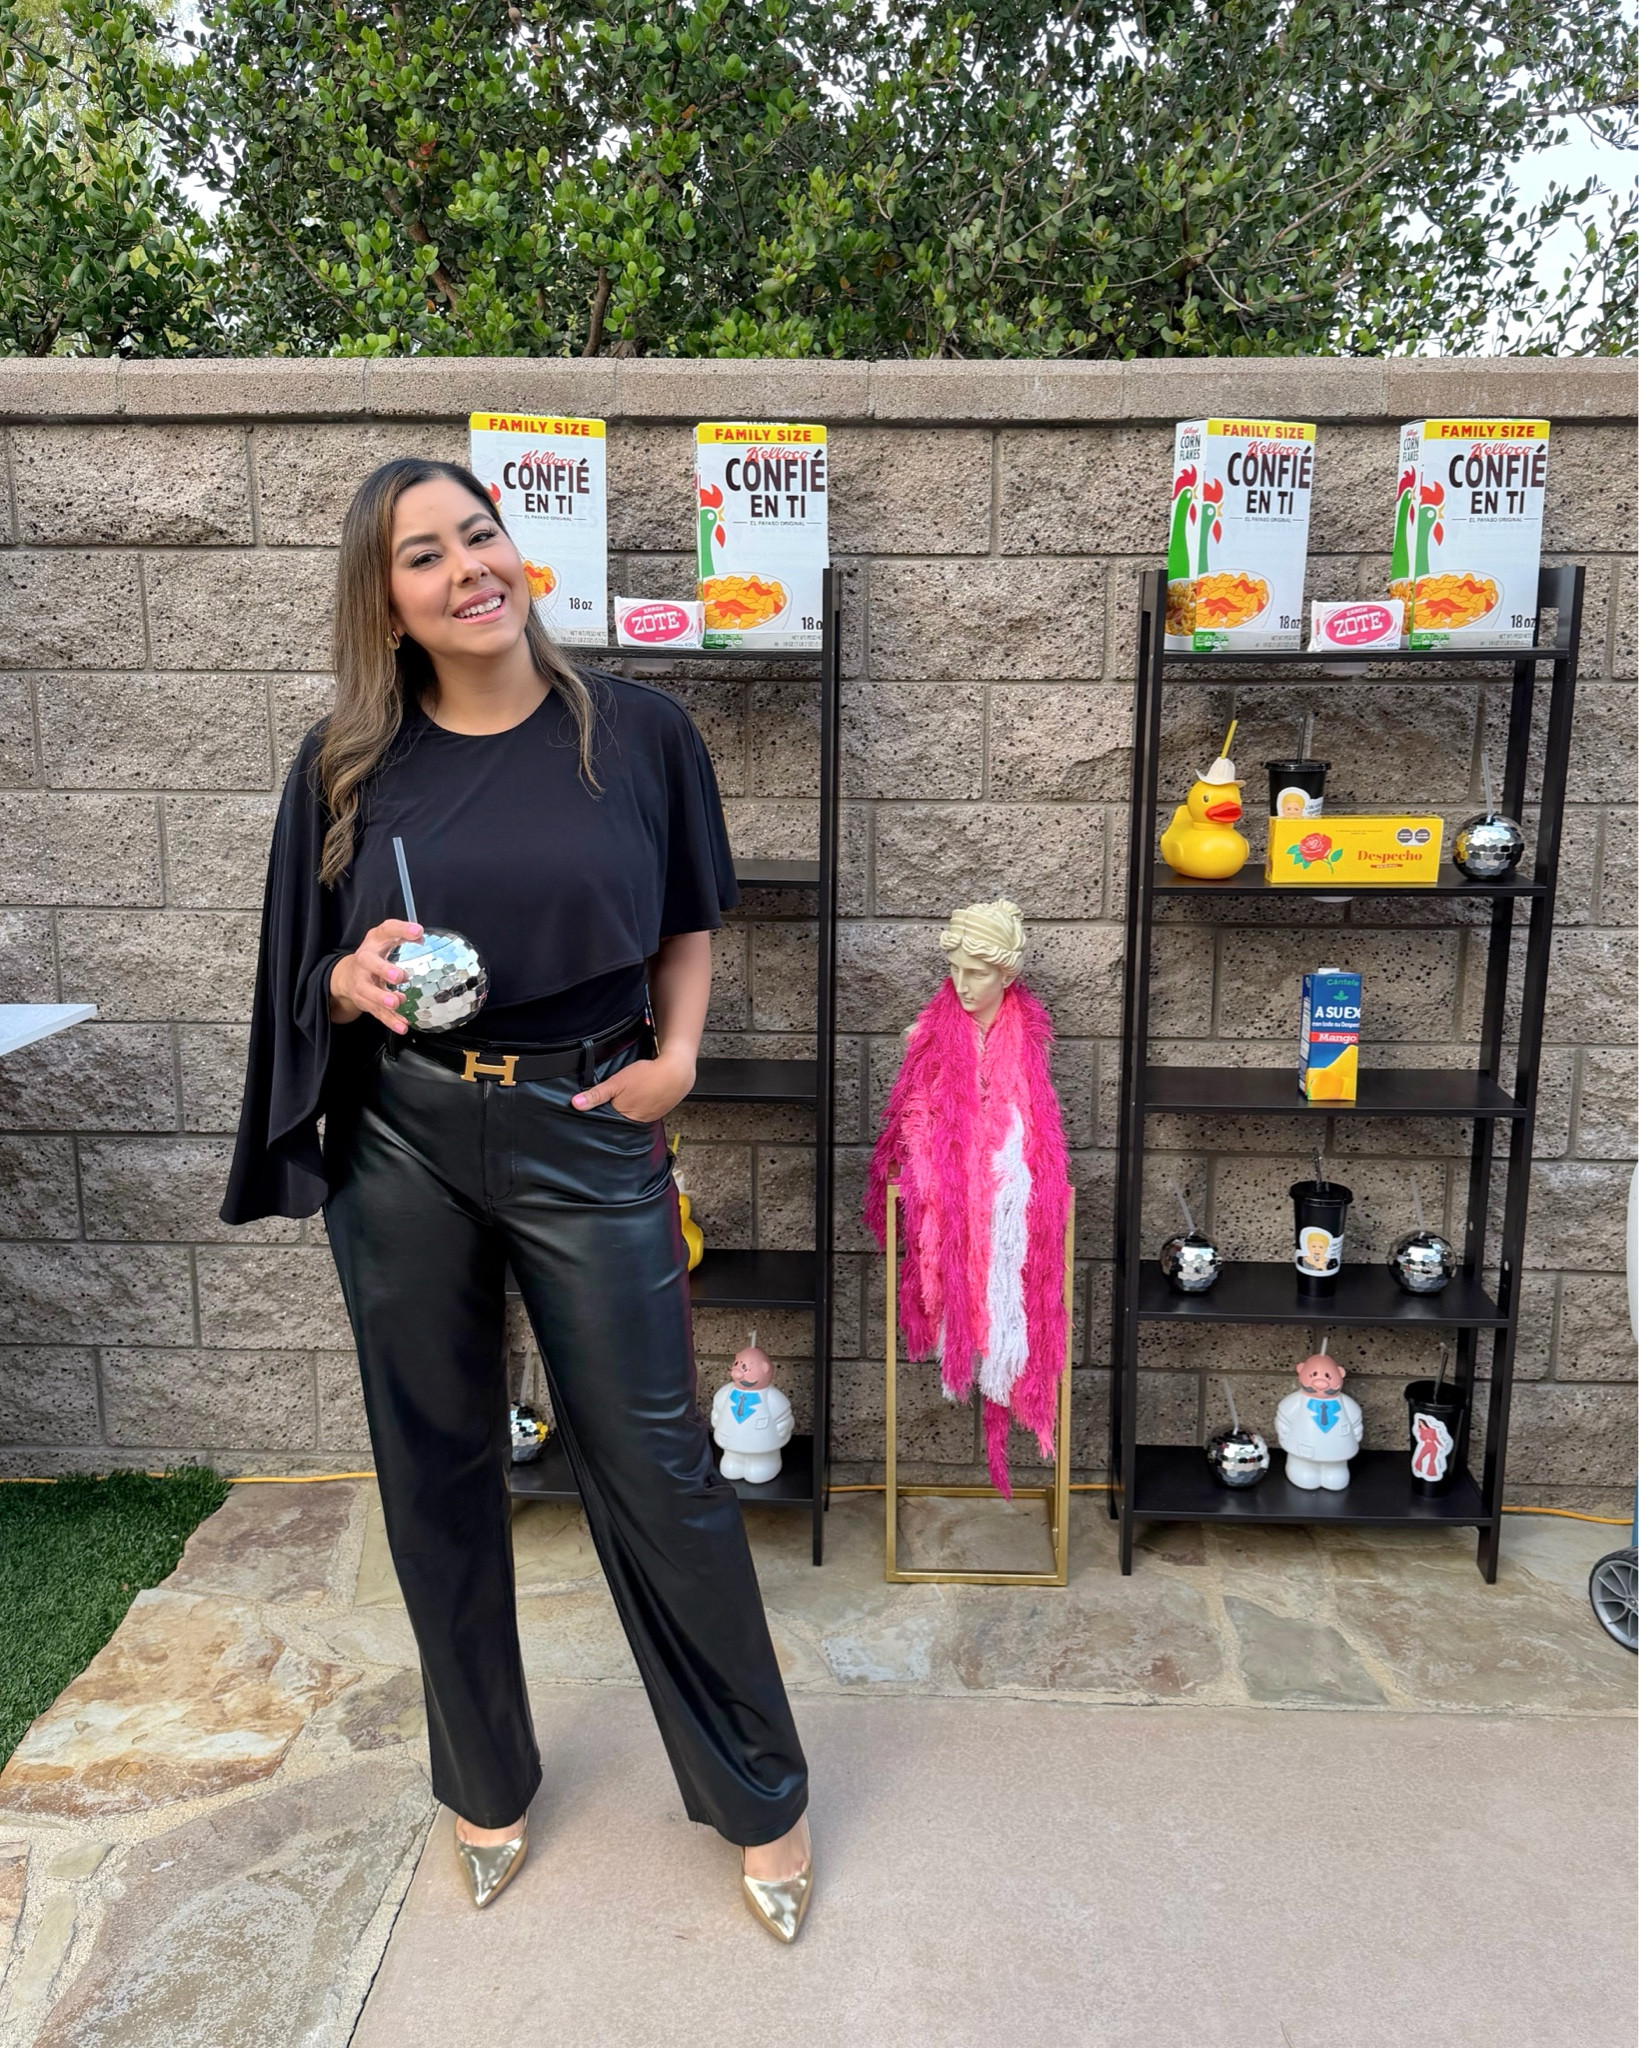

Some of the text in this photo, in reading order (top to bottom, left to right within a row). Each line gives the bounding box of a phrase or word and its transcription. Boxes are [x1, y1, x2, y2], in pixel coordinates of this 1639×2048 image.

[489, 418, 590, 436] FAMILY SIZE
[715, 428, 812, 442] FAMILY SIZE
[1222, 424, 1305, 439] FAMILY SIZE
[1441, 425, 1535, 437] FAMILY SIZE
[1180, 434, 1201, 449] CORN
[725, 449, 826, 492] CONFIÉ
[1227, 445, 1313, 489] CONFIÉ
[1449, 444, 1546, 488] CONFIÉ
[503, 457, 590, 494] CONFIÉ
[525, 493, 572, 514] EN TI
[751, 495, 805, 518] EN TI
[1246, 490, 1294, 515] EN TI
[1471, 491, 1525, 514] EN TI
[569, 597, 593, 611] 18 oz
[631, 611, 680, 634] ZOTE
[801, 617, 823, 630] 18 o
[1279, 616, 1289, 629] 18
[1290, 619, 1301, 629] oz
[1333, 611, 1383, 638] ZOTE
[1511, 615, 1536, 628] 18 oz
[1357, 849, 1423, 863] Despecho
[1319, 1032, 1357, 1044] Mango
